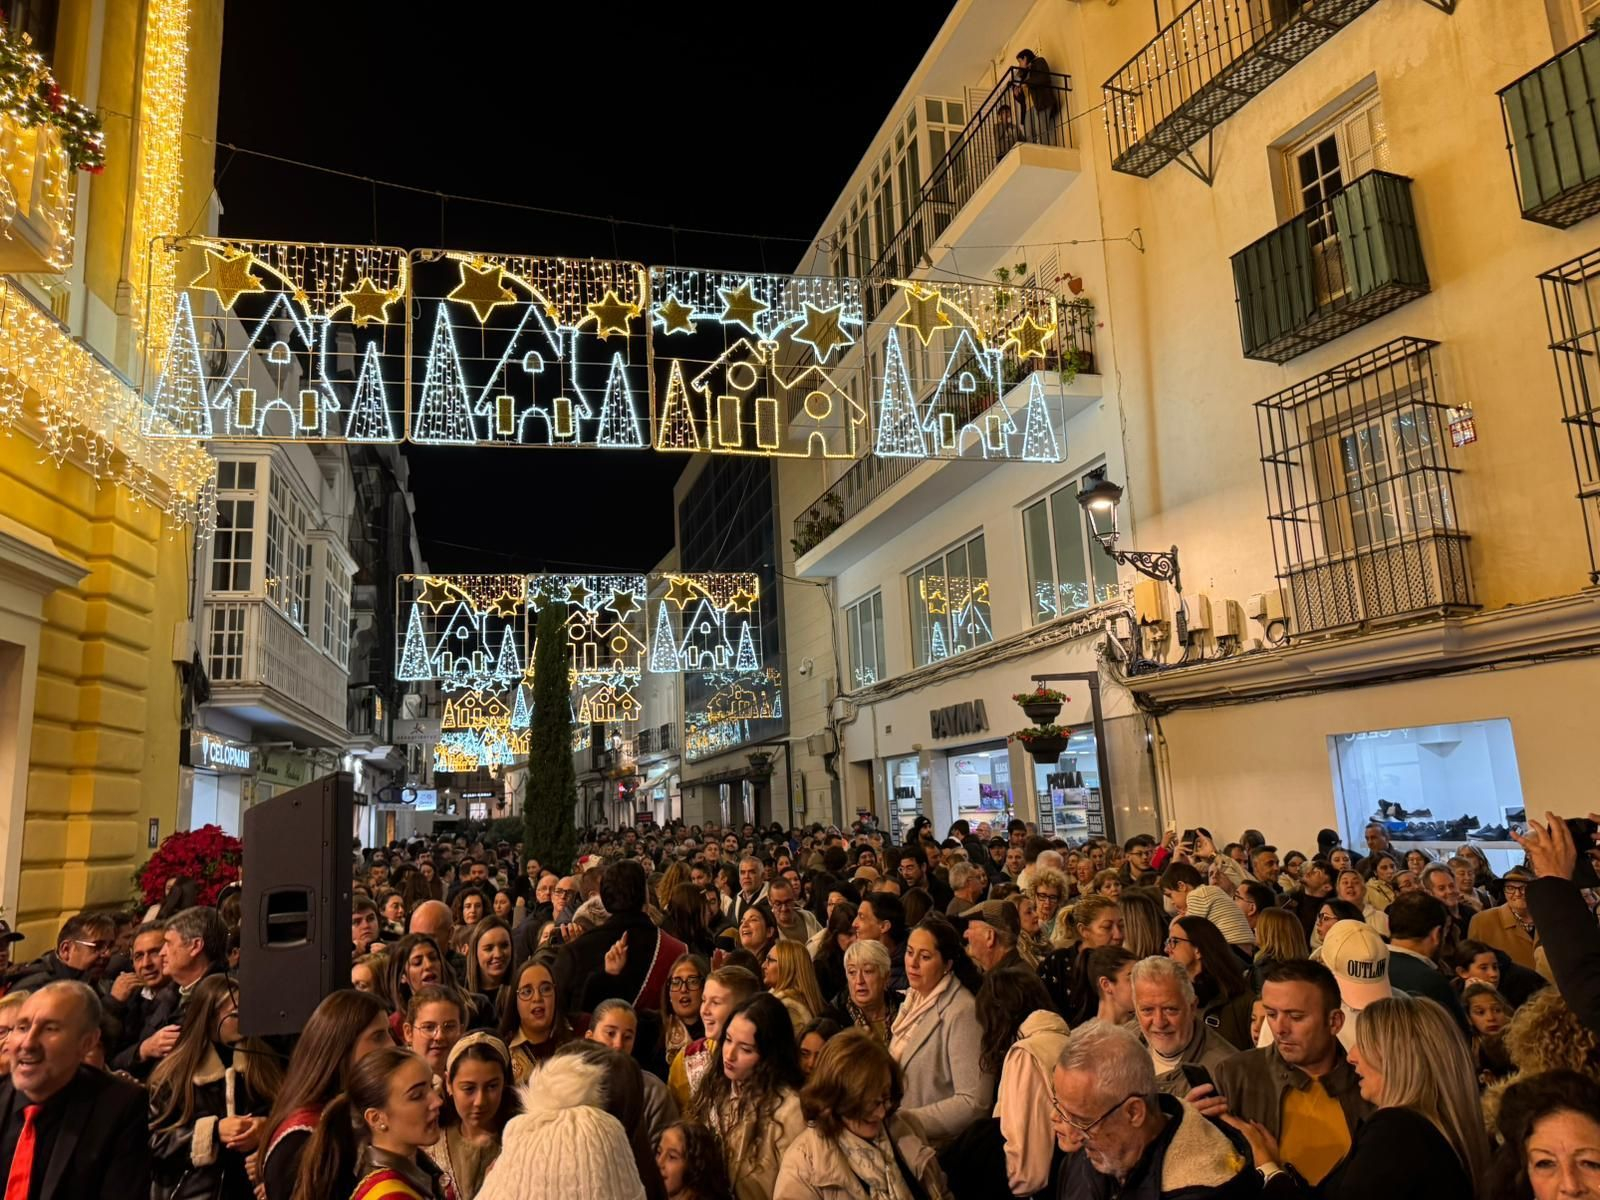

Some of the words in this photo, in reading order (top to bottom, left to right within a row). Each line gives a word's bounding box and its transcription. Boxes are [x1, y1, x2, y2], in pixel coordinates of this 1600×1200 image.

[929, 698, 989, 739] PAYMA
[210, 742, 250, 769] CELOPMAN
[1347, 959, 1386, 978] OUTLAW
